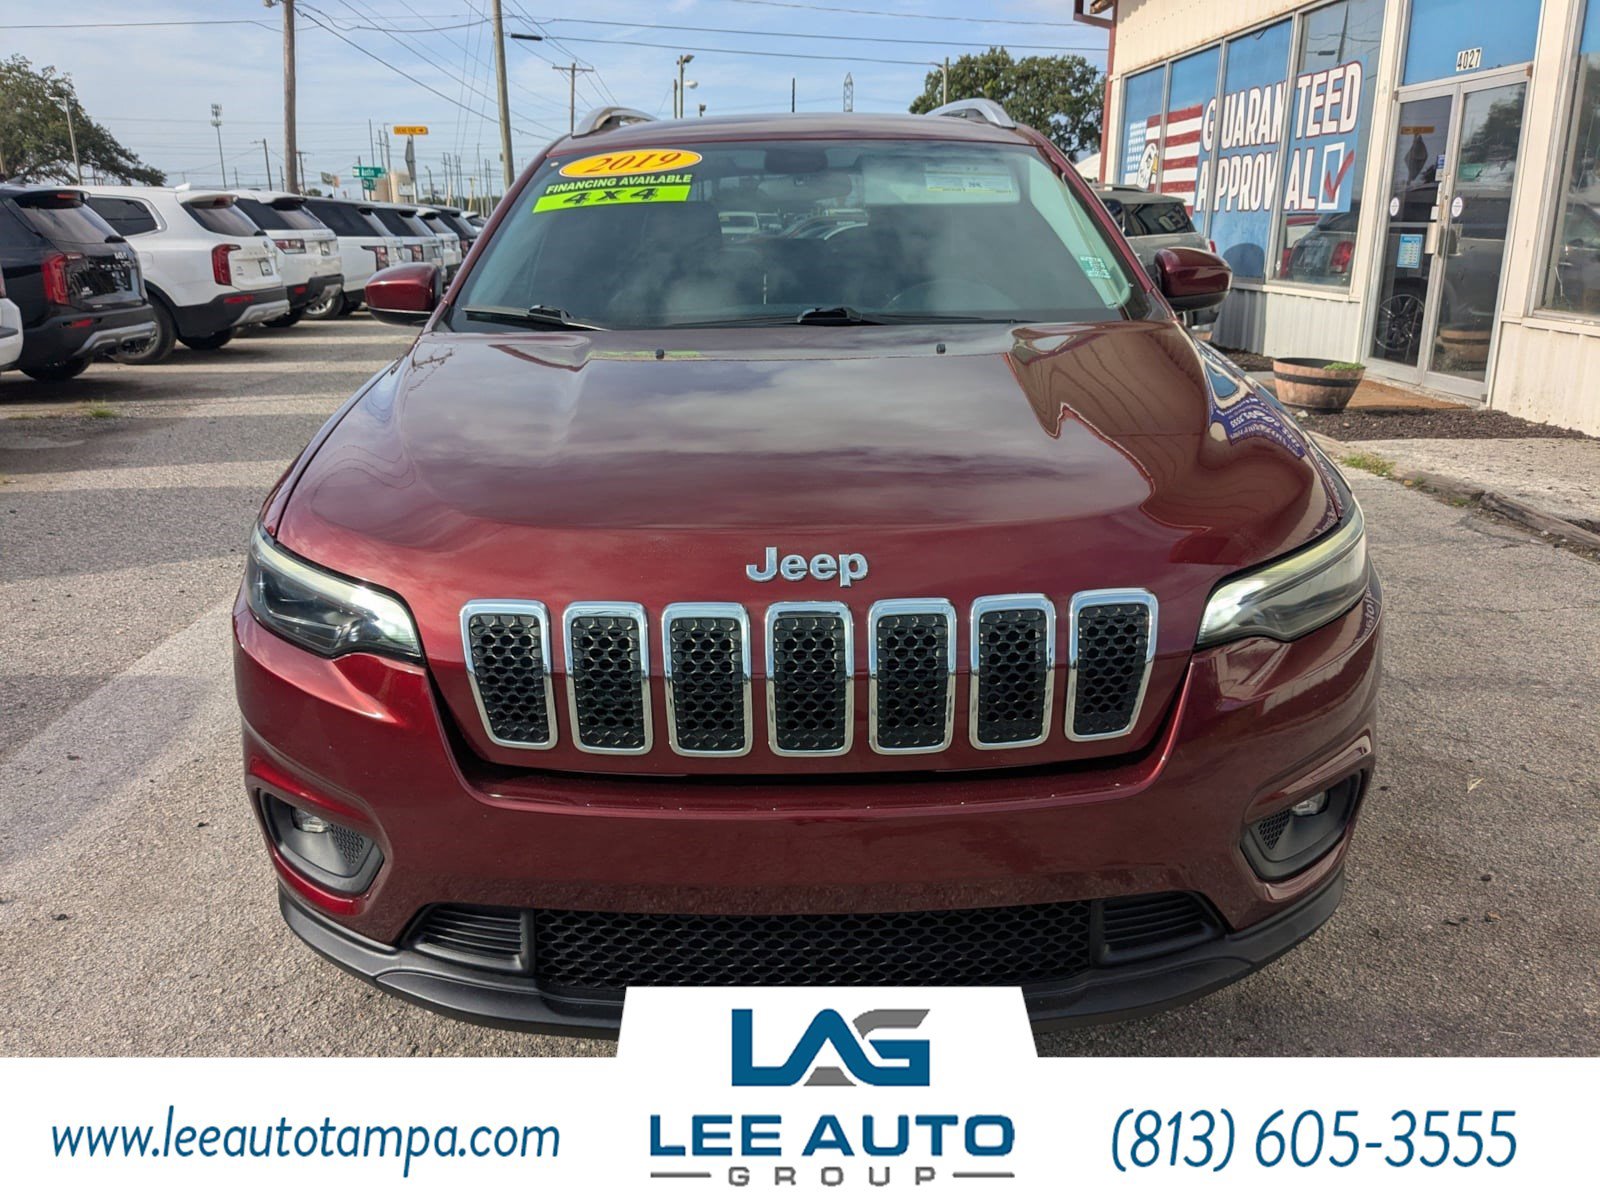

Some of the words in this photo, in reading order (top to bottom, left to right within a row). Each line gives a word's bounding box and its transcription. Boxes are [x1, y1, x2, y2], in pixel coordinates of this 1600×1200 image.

[1457, 49, 1480, 69] 4027
[1202, 61, 1362, 151] GUARANTEED
[585, 152, 681, 173] 2019
[545, 178, 617, 194] FINANCING
[619, 174, 693, 187] AVAILABLE
[1195, 147, 1316, 212] APPROVAL
[746, 547, 868, 587] Jeep
